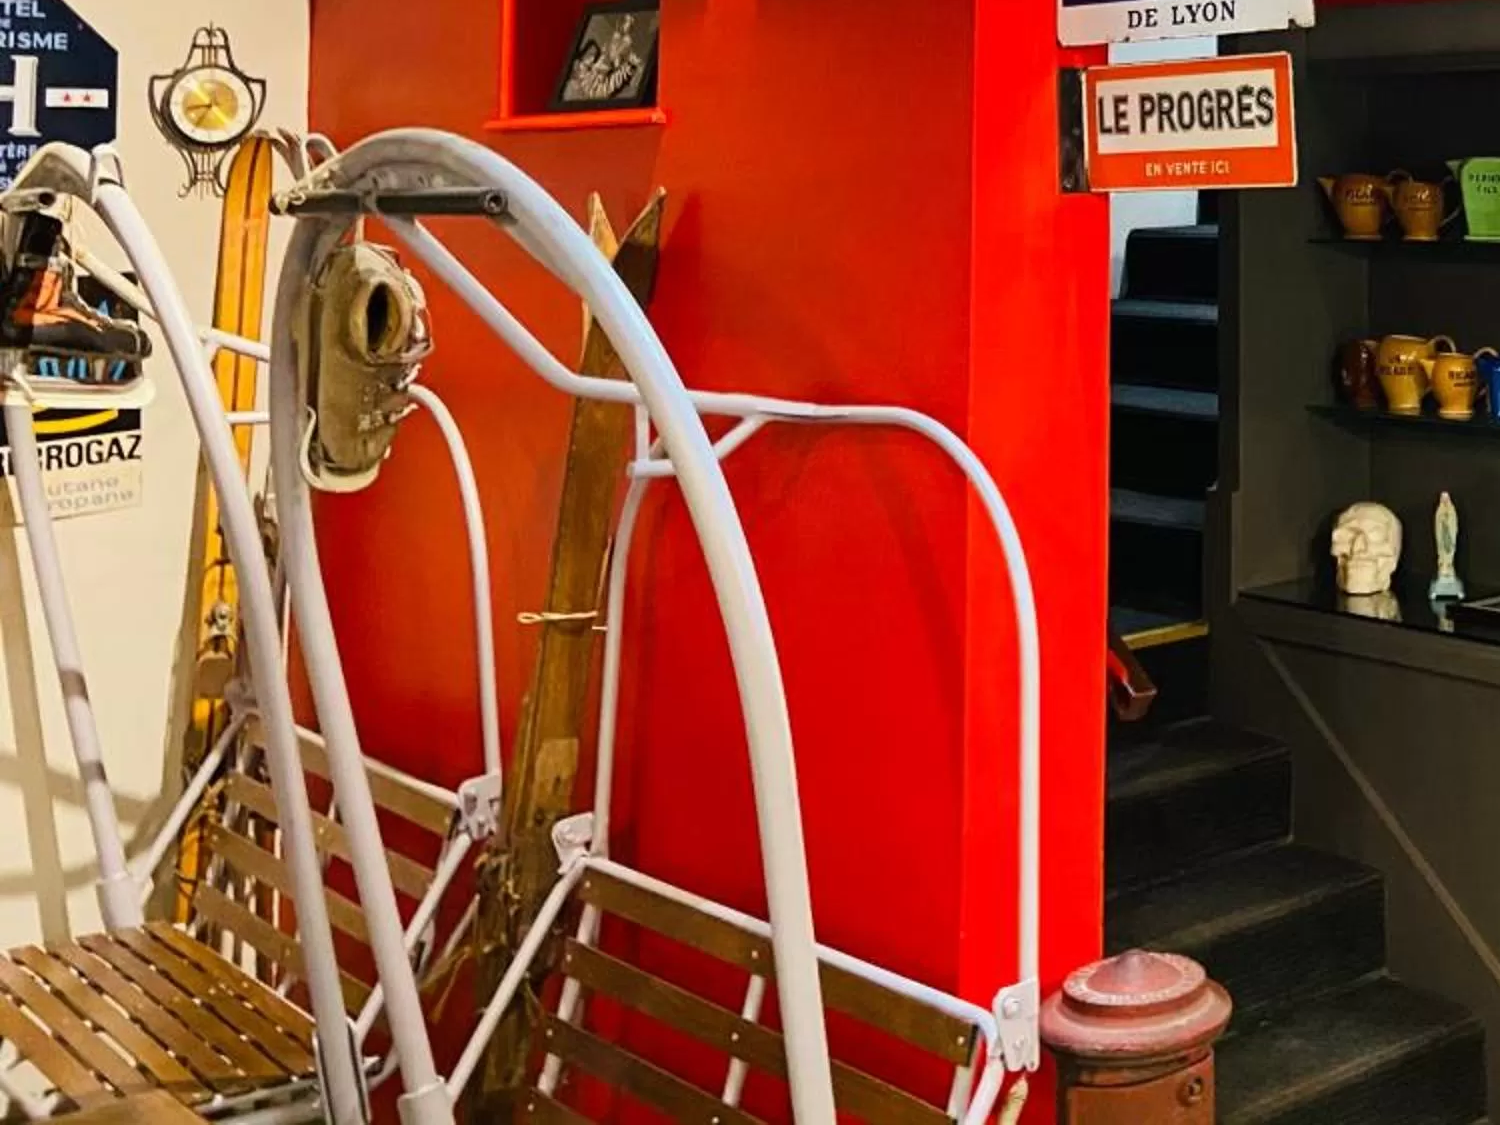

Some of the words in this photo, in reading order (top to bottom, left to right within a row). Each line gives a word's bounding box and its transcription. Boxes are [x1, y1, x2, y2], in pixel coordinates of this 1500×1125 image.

[1128, 8, 1158, 29] DE
[1172, 0, 1236, 26] LYON
[1098, 93, 1130, 135] LE
[1145, 162, 1162, 177] EN
[1166, 160, 1208, 175] VENTE
[1211, 160, 1231, 174] ICI
[47, 475, 119, 497] utane
[47, 491, 135, 512] ropane
